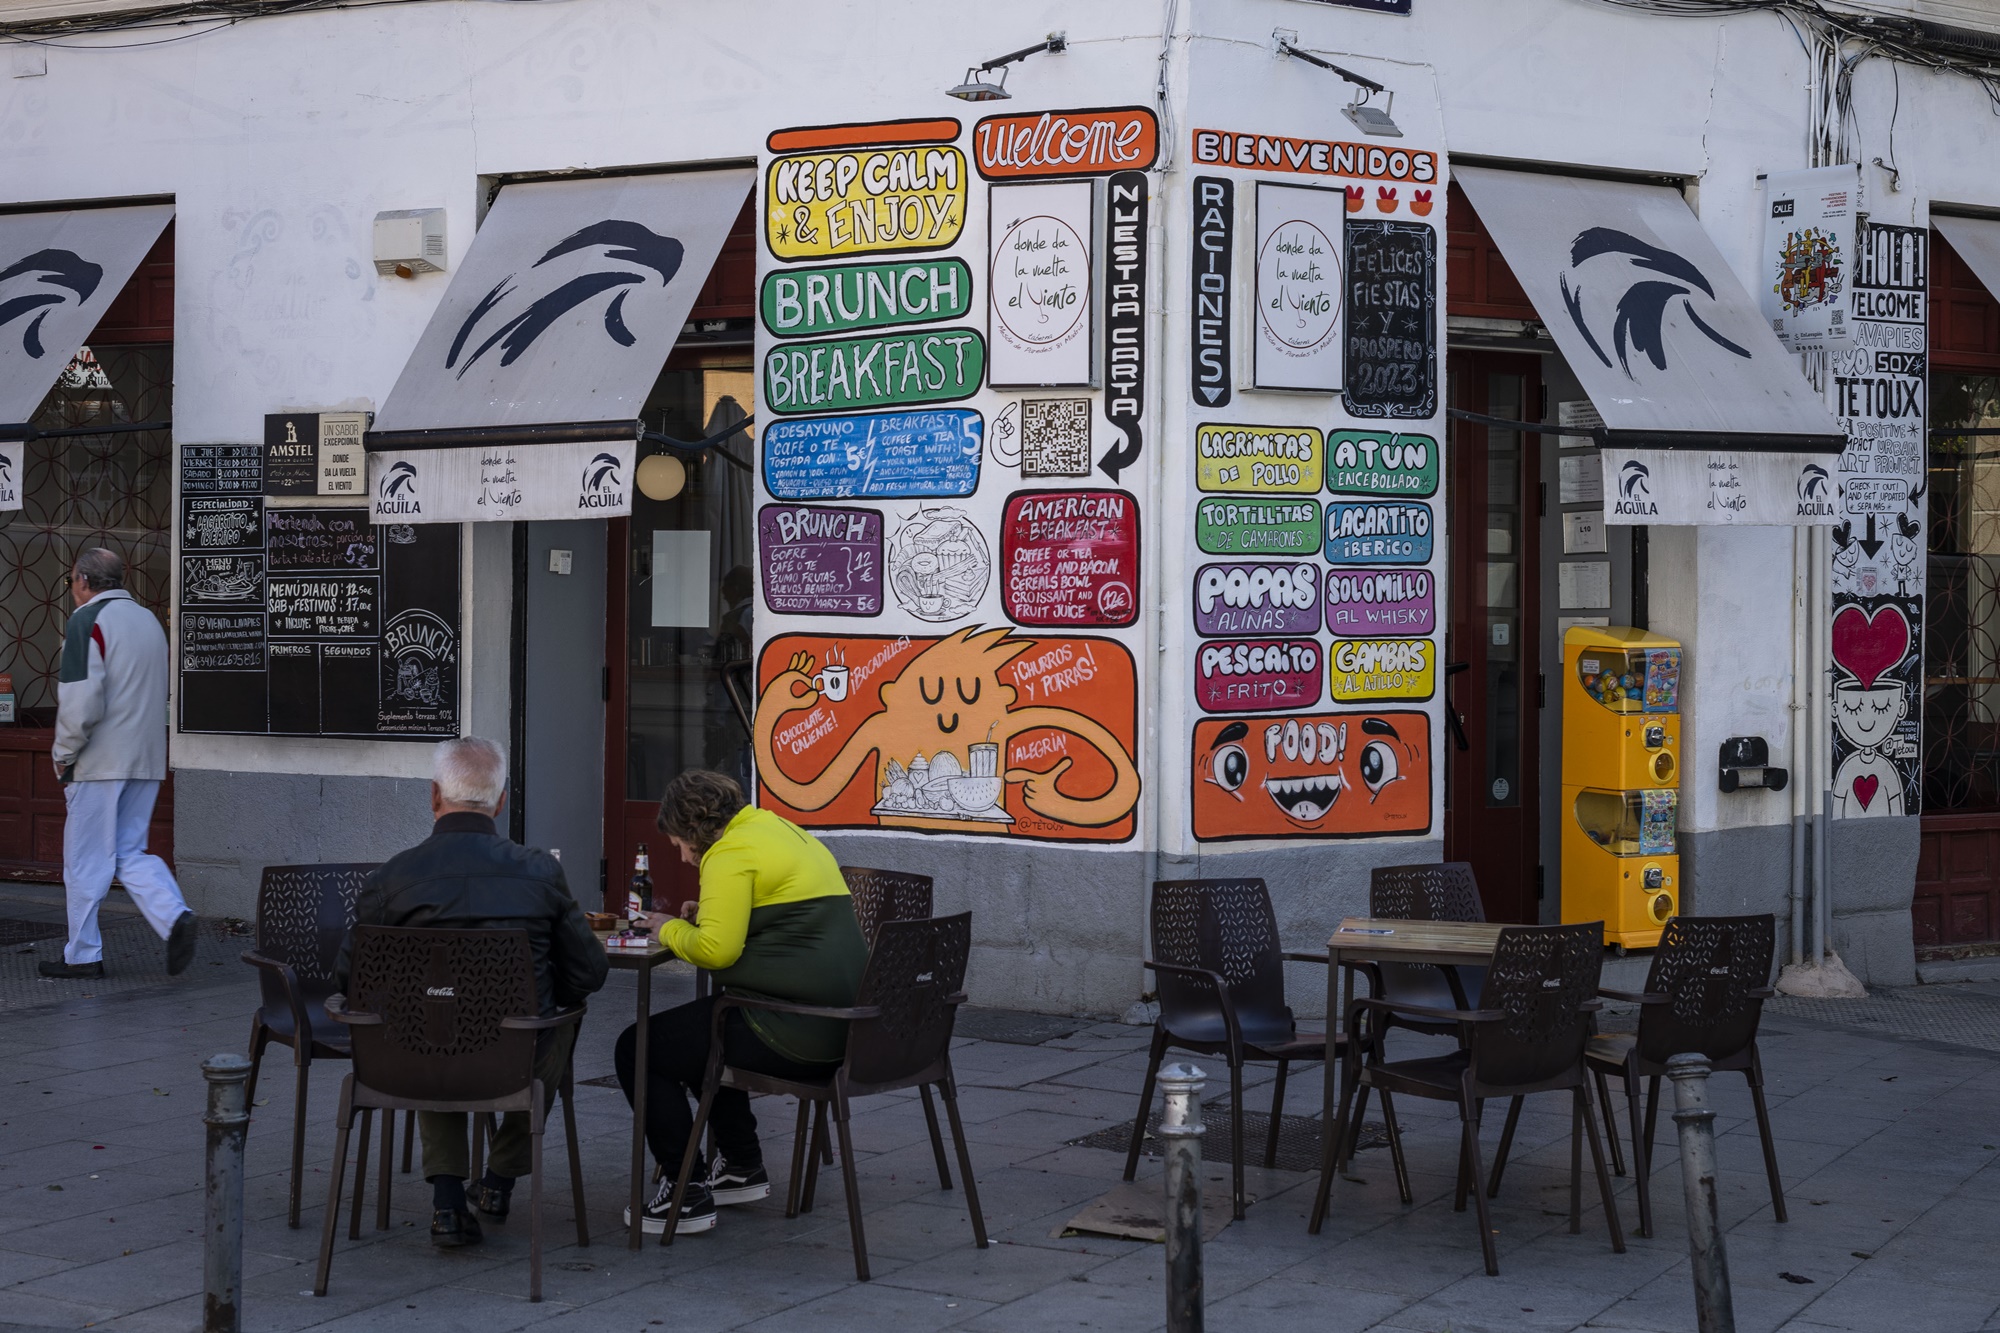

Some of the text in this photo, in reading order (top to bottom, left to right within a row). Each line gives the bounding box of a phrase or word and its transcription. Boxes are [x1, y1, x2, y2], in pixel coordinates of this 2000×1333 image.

[1196, 131, 1436, 182] BIENVENIDOS
[776, 149, 958, 205] KEEP CALM
[793, 194, 956, 249] & ENJOY
[1014, 228, 1069, 251] donde da
[1276, 232, 1324, 255] donde da
[1014, 254, 1070, 278] la vuelta
[1276, 258, 1324, 283] la vuelta
[1199, 183, 1226, 383] RACIONES
[776, 267, 958, 328] BRUNCH
[1009, 282, 1022, 309] el
[1110, 185, 1140, 416] NUESTRA CARTA
[1271, 285, 1284, 311] el
[1378, 311, 1394, 334] Y
[1350, 336, 1423, 361] PROSPERO
[767, 336, 973, 406] BREAKFAST
[1878, 353, 1915, 373] SOY
[1358, 363, 1417, 396] 2023
[324, 424, 359, 436] UN SABOR
[779, 421, 854, 439] DESAYUNO
[880, 413, 957, 433] BREAKFAST
[324, 437, 360, 446] EXCEPCIONAL
[882, 431, 954, 446] COFFEE TEA
[269, 444, 314, 456] AMSTEL
[885, 444, 918, 456] TOAST
[1334, 433, 1428, 470] ATÚN
[1877, 439, 1918, 457] URBAN
[332, 454, 349, 463] DONDE
[480, 450, 516, 467] donde da
[769, 455, 811, 468] TOSTADA
[1707, 455, 1739, 470] donde da
[325, 467, 356, 476] DA LA VUELTA
[481, 469, 518, 485] la vuelta
[1219, 461, 1300, 486] DE POLLO
[1337, 471, 1420, 489] ENCEBOLLADO
[328, 481, 352, 490] EL VIENTO
[602, 485, 611, 494] EL
[1708, 473, 1741, 489] la vuelta
[1850, 482, 1899, 491] CHECK IT OUT!
[477, 488, 487, 506] el
[578, 493, 623, 509] ÁGUILA
[1707, 492, 1715, 509] el
[1848, 492, 1862, 500] AND
[1863, 492, 1877, 500] GET
[376, 499, 421, 514] ÁGUILA
[1614, 500, 1659, 515] ÁGUILA
[1797, 501, 1834, 516] ÁGUILA
[329, 520, 354, 532] con
[775, 508, 867, 545] BRUNCH
[1029, 519, 1109, 542] BREAKFAST
[1217, 529, 1304, 550] DE CAMARONES
[771, 548, 808, 561] GOFRE
[1014, 547, 1051, 562] COFFEE
[1057, 549, 1069, 559] OR
[769, 557, 794, 574] CAFÉ
[1012, 563, 1022, 576] 2
[1023, 563, 1051, 577] EGGS
[1055, 561, 1079, 575] AND
[770, 570, 837, 584] ZUMO FRUTAS
[1010, 575, 1092, 591] CEREALS BOWL
[269, 580, 300, 597] MENÚ
[302, 583, 339, 597] DIARIO
[770, 584, 802, 595] HUEVOS
[1012, 588, 1093, 604] CROISSANT AND
[1199, 562, 1317, 615] PAPAS
[269, 599, 287, 613] SAB
[294, 598, 337, 613] FESTIVOS
[774, 598, 841, 609] BLOODY MARY
[1336, 608, 1429, 625] AL WHISKY
[270, 645, 312, 655] PRIMEROS
[324, 646, 371, 655] SEGUNDOS
[385, 623, 453, 662] BRUNCH
[1011, 644, 1073, 686] ¡CHURROS
[1336, 641, 1427, 674] GAMBAS
[1041, 642, 1098, 698] PORRAS!
[1342, 675, 1360, 694] AL
[775, 708, 825, 752] ¡CHOCOLATE
[1264, 718, 1348, 765] FOOD!
